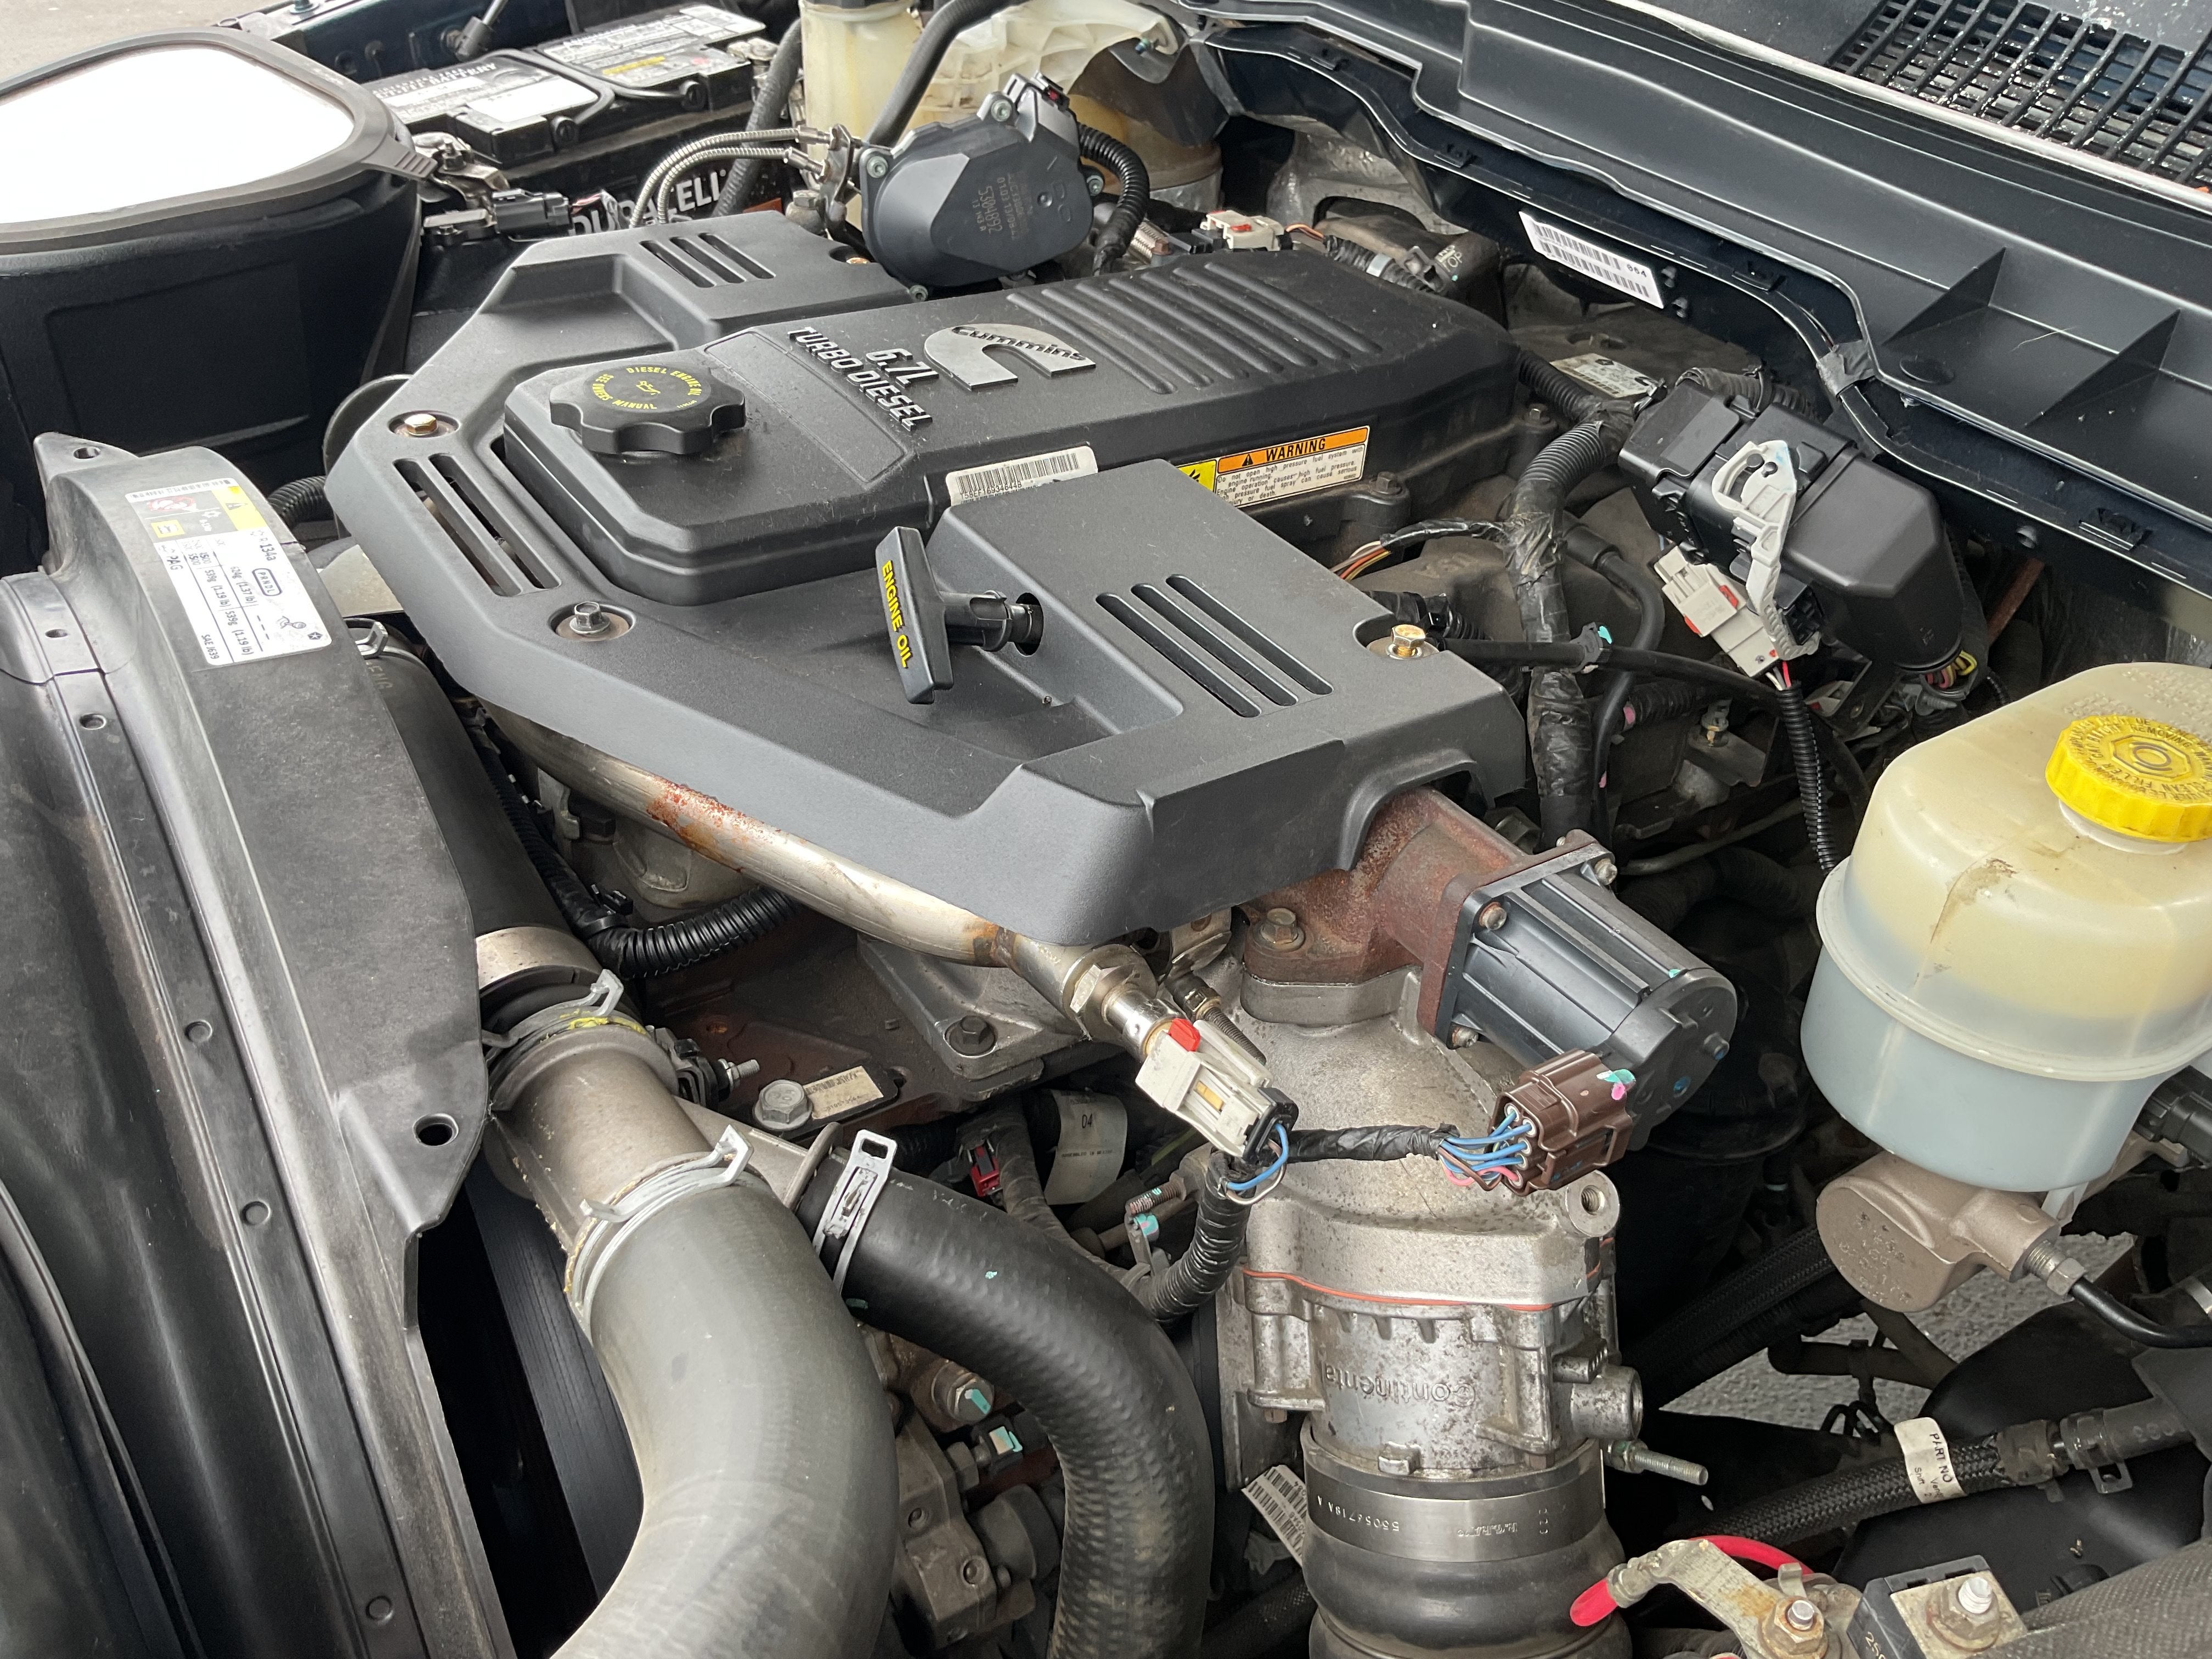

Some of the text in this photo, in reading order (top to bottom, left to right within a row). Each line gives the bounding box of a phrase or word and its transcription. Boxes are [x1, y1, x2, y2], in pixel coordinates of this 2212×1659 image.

[670, 370, 702, 387] ENGINE
[787, 326, 933, 431] TURBO DIESEL
[612, 399, 657, 409] MANUAL
[1246, 469, 1260, 477] open
[1283, 459, 1307, 469] pressure
[1313, 454, 1323, 462] fuel
[1328, 450, 1347, 460] system
[1266, 438, 1325, 461] WARNING
[1217, 487, 1236, 495] Engine
[1242, 479, 1268, 490] operation
[1273, 473, 1293, 483] causes
[1316, 465, 1326, 473] fuel
[1331, 460, 1355, 471] pressure.
[1228, 478, 1248, 488] engine
[1235, 487, 1260, 498] pressure
[1265, 484, 1276, 492] fuel
[1280, 480, 1296, 489] spray
[1338, 466, 1357, 475] serious
[1259, 490, 1276, 499] death.
[167, 555, 184, 571] PAG
[205, 569, 232, 607] 539g (1.19 lb)
[230, 566, 258, 604] 624g (1.37 lb)
[257, 572, 275, 593] PRNDL
[881, 560, 911, 669] ENGINE OIL
[201, 634, 220, 659] SAE J639
[225, 611, 254, 656] 539g (1.19 lb)
[2101, 763, 2153, 788] FILLER
[2129, 723, 2193, 748] REMOVING
[1082, 1113, 1093, 1128] 04
[1320, 1361, 1476, 1407] Continental
[1929, 1432, 1953, 1483] PART NO
